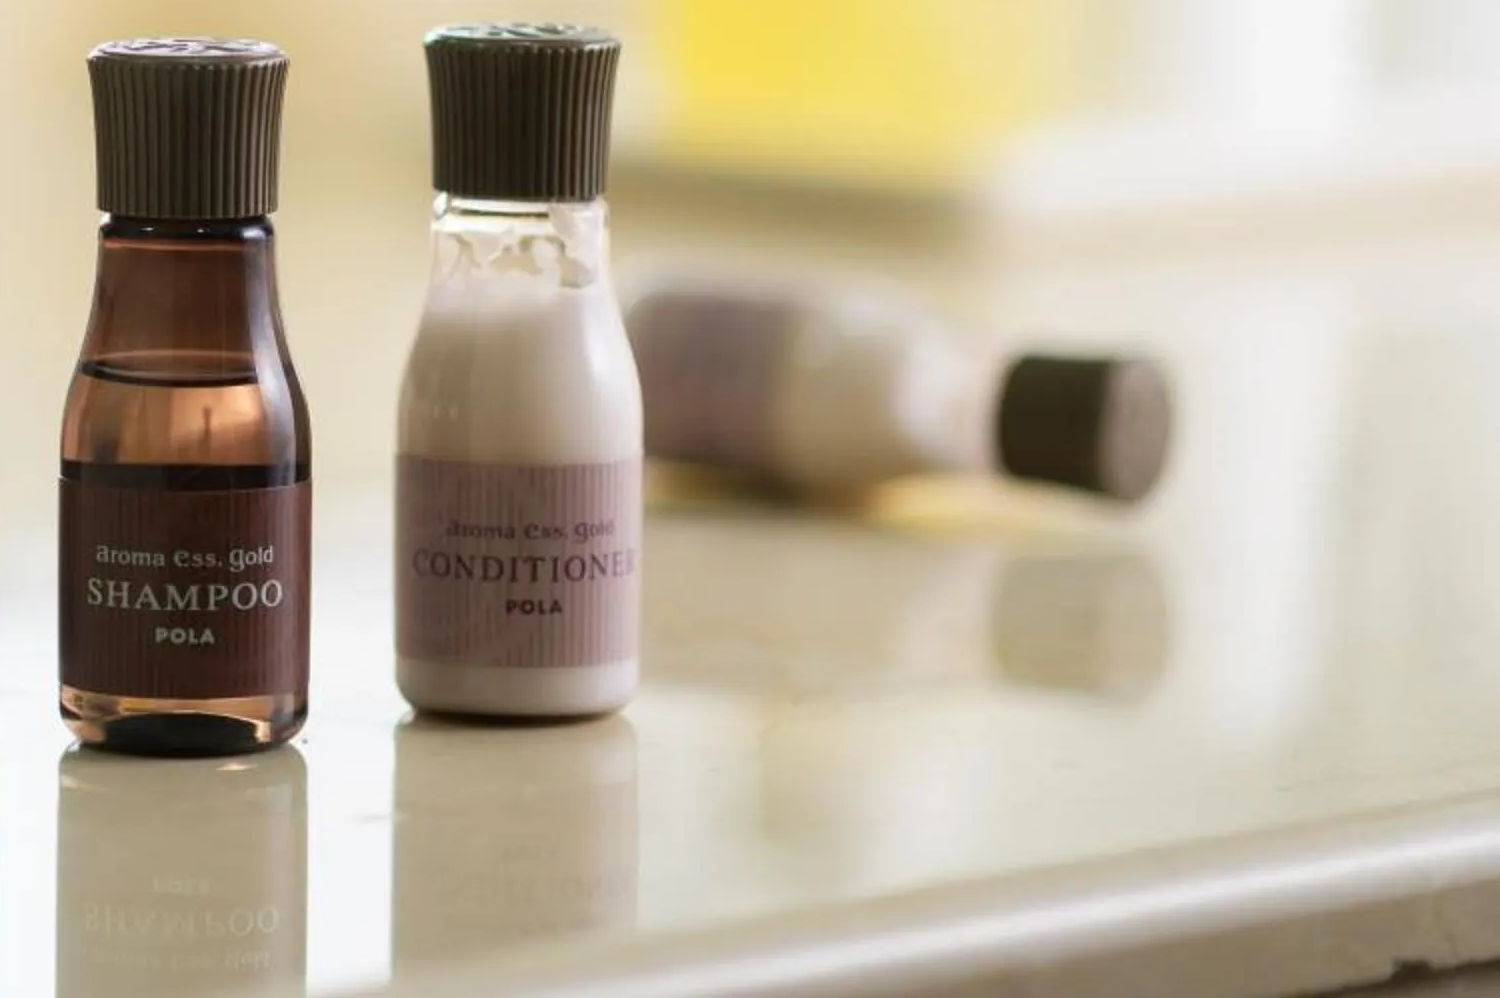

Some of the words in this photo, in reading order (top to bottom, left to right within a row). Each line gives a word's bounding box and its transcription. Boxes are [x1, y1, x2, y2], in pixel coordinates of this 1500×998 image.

[446, 518, 516, 540] aroma
[574, 518, 615, 545] gold
[96, 545, 166, 568] aroma
[174, 549, 224, 568] ess.
[229, 545, 275, 573] gold
[87, 577, 284, 612] SHAMPOO
[505, 599, 563, 616] POLA
[155, 626, 215, 645] POLA
